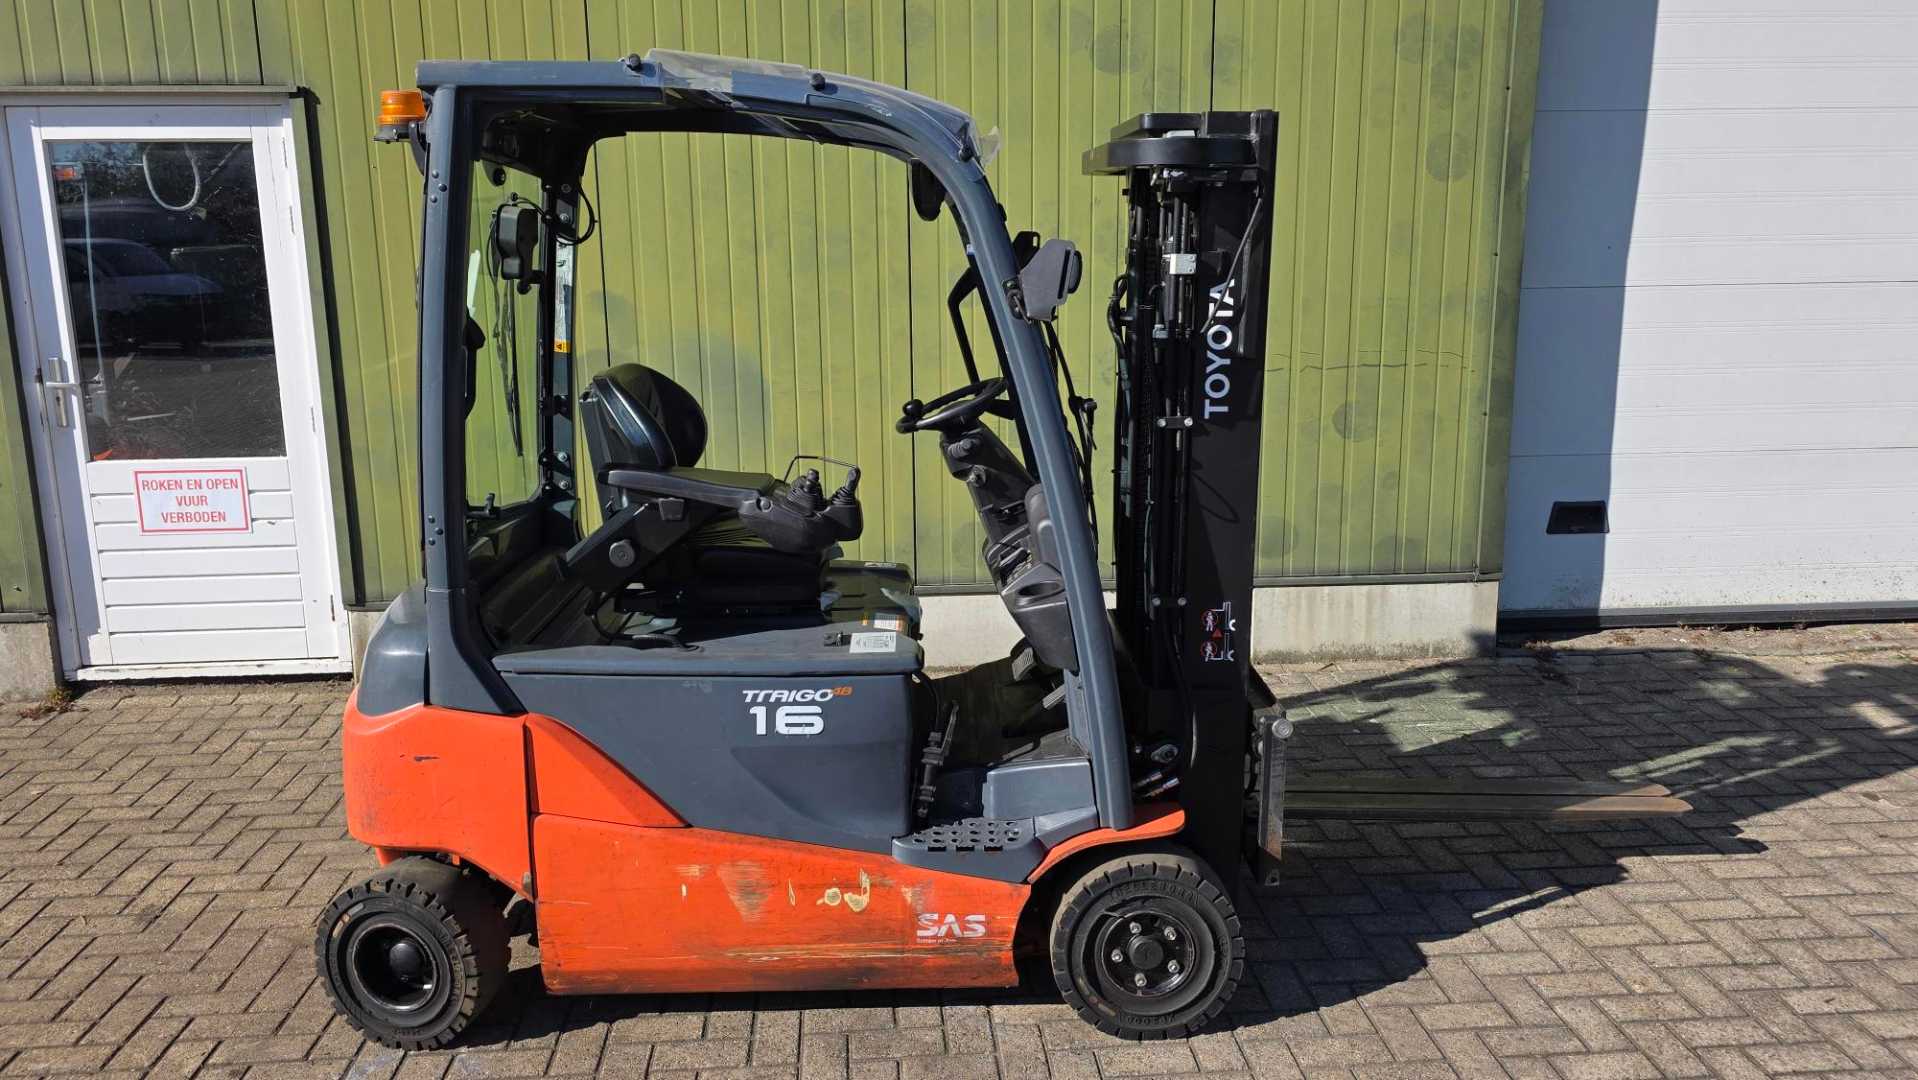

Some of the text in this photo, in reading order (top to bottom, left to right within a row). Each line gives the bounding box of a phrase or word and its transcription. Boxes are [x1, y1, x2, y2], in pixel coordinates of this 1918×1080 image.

[1204, 278, 1235, 420] TOYOTA
[142, 478, 239, 491] ROKEN EN OPEN
[175, 495, 208, 506] VUUR
[161, 511, 226, 523] VERBODEN
[749, 705, 825, 736] 16
[916, 912, 986, 937] SAS
